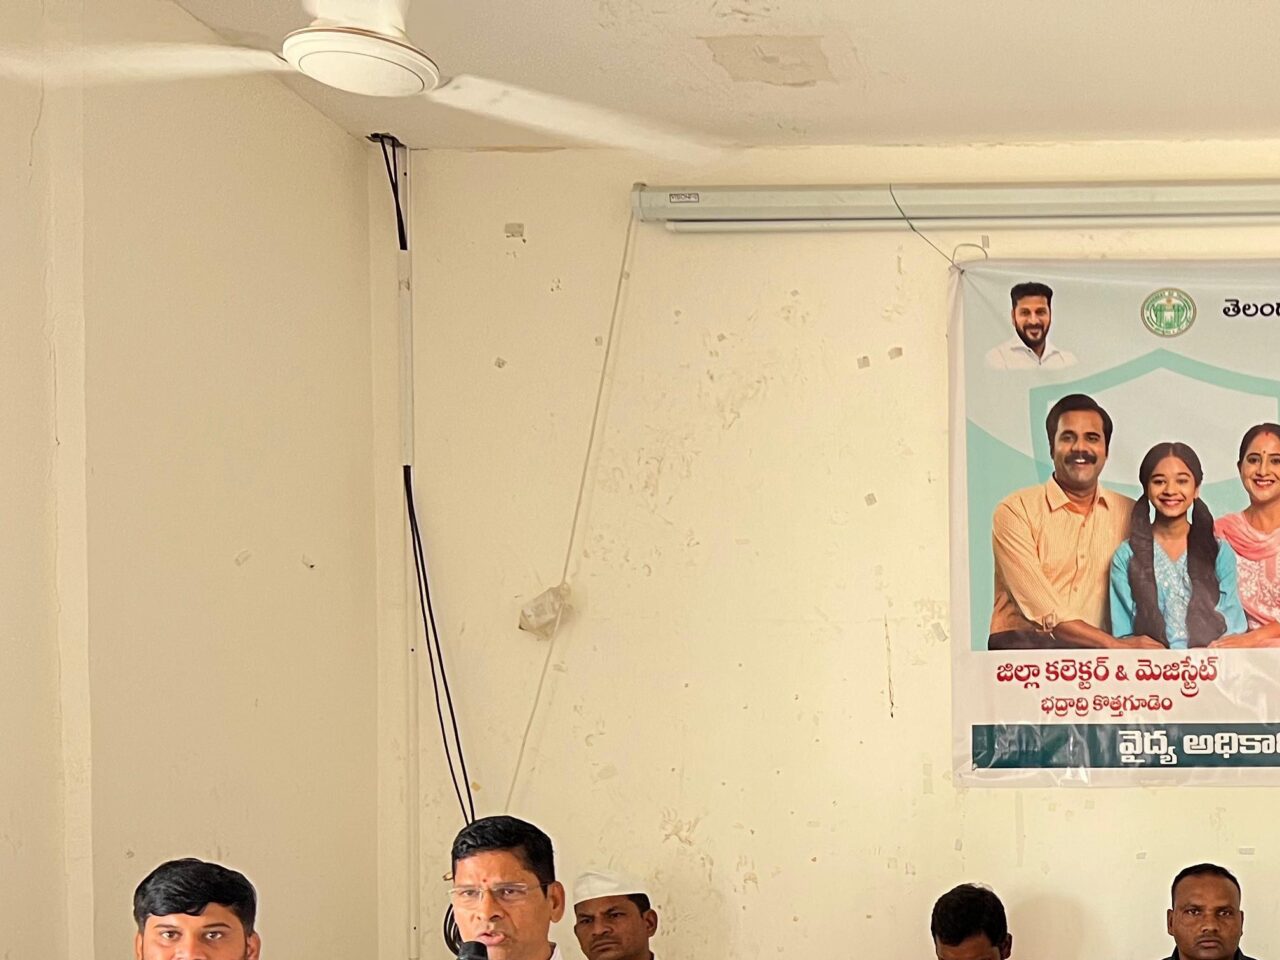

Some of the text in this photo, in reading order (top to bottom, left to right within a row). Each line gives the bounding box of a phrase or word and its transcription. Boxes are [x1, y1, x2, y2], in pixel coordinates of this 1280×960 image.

[996, 656, 1219, 697] జిల్లా కలెక్టర్ & మెజిస్ట్రేట్
[1040, 694, 1173, 717] భద్రాద్రి కొత్తగూడెం
[1118, 729, 1178, 765] వైద్య
